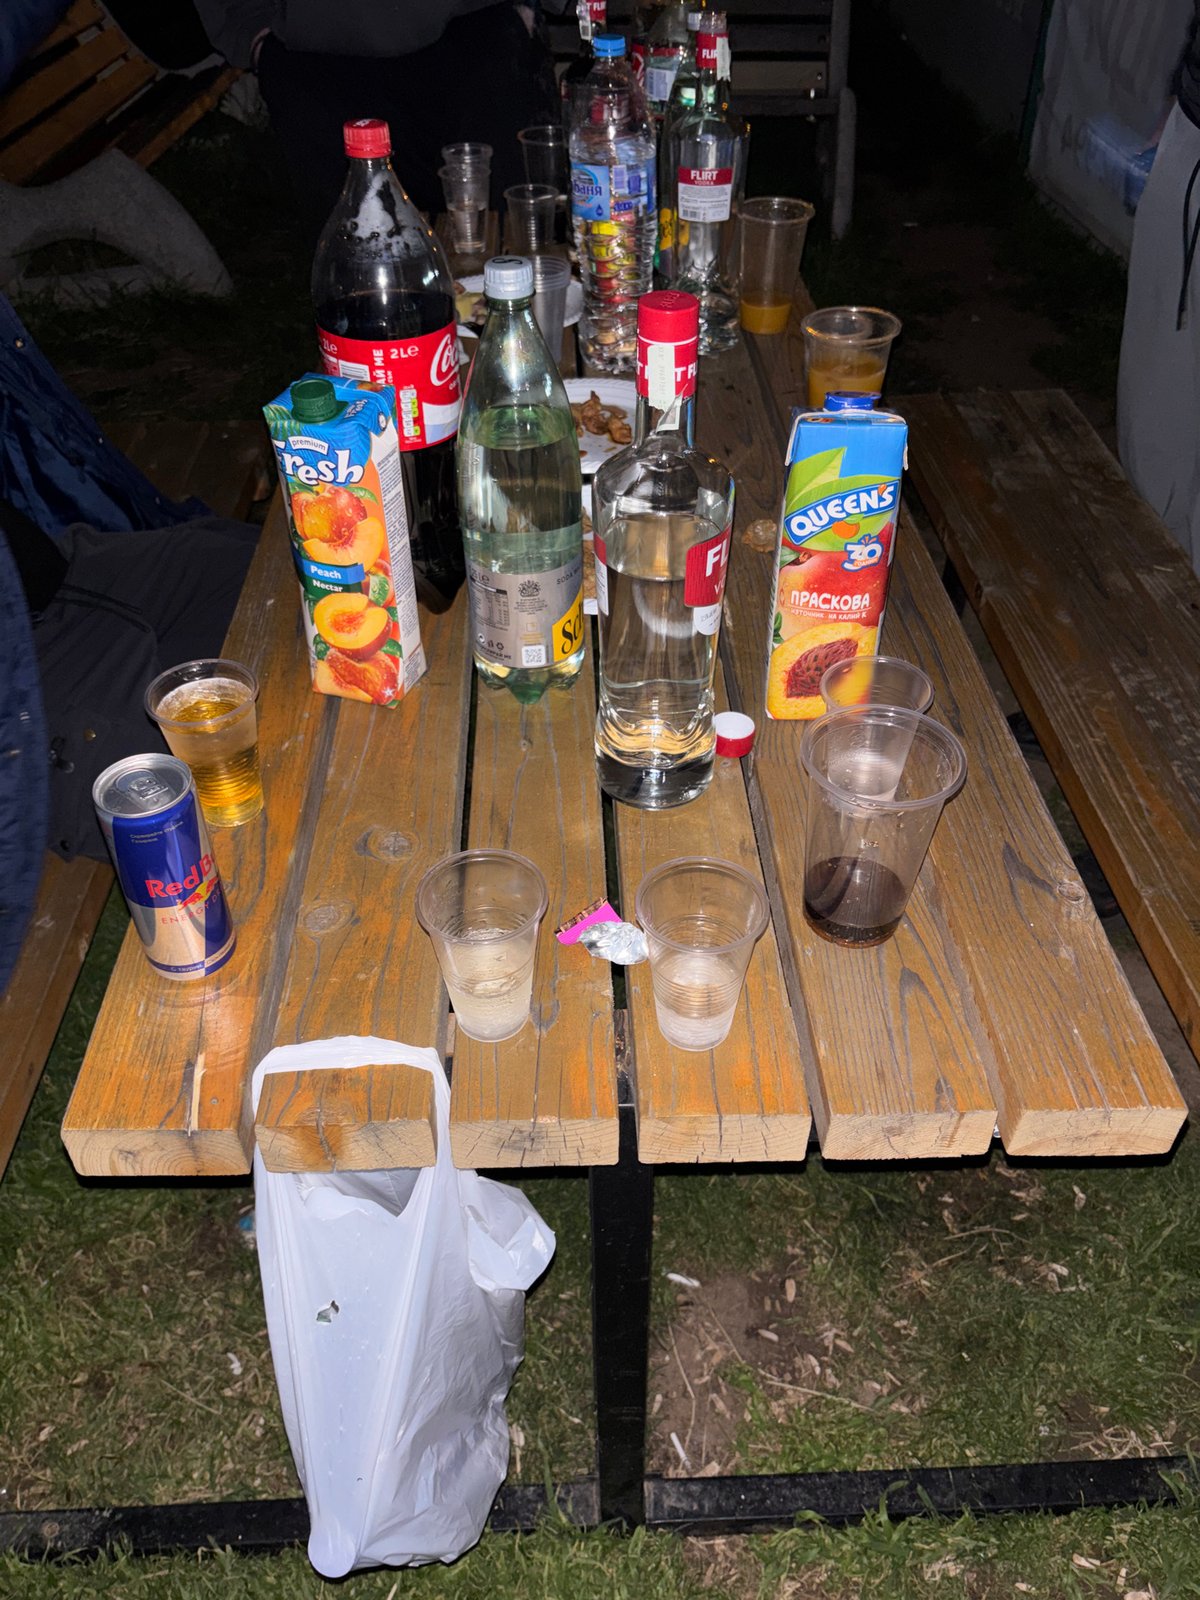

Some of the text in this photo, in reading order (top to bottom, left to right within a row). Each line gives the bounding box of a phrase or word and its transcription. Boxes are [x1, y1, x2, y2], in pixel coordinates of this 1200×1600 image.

[690, 169, 719, 181] FLIRT
[292, 438, 326, 452] premium
[272, 440, 365, 486] resh
[310, 565, 342, 580] Peach
[312, 579, 344, 593] Nectar
[790, 590, 871, 611] ПРАСКОВА
[145, 865, 200, 899] Red
[161, 900, 210, 926] ENERGY
